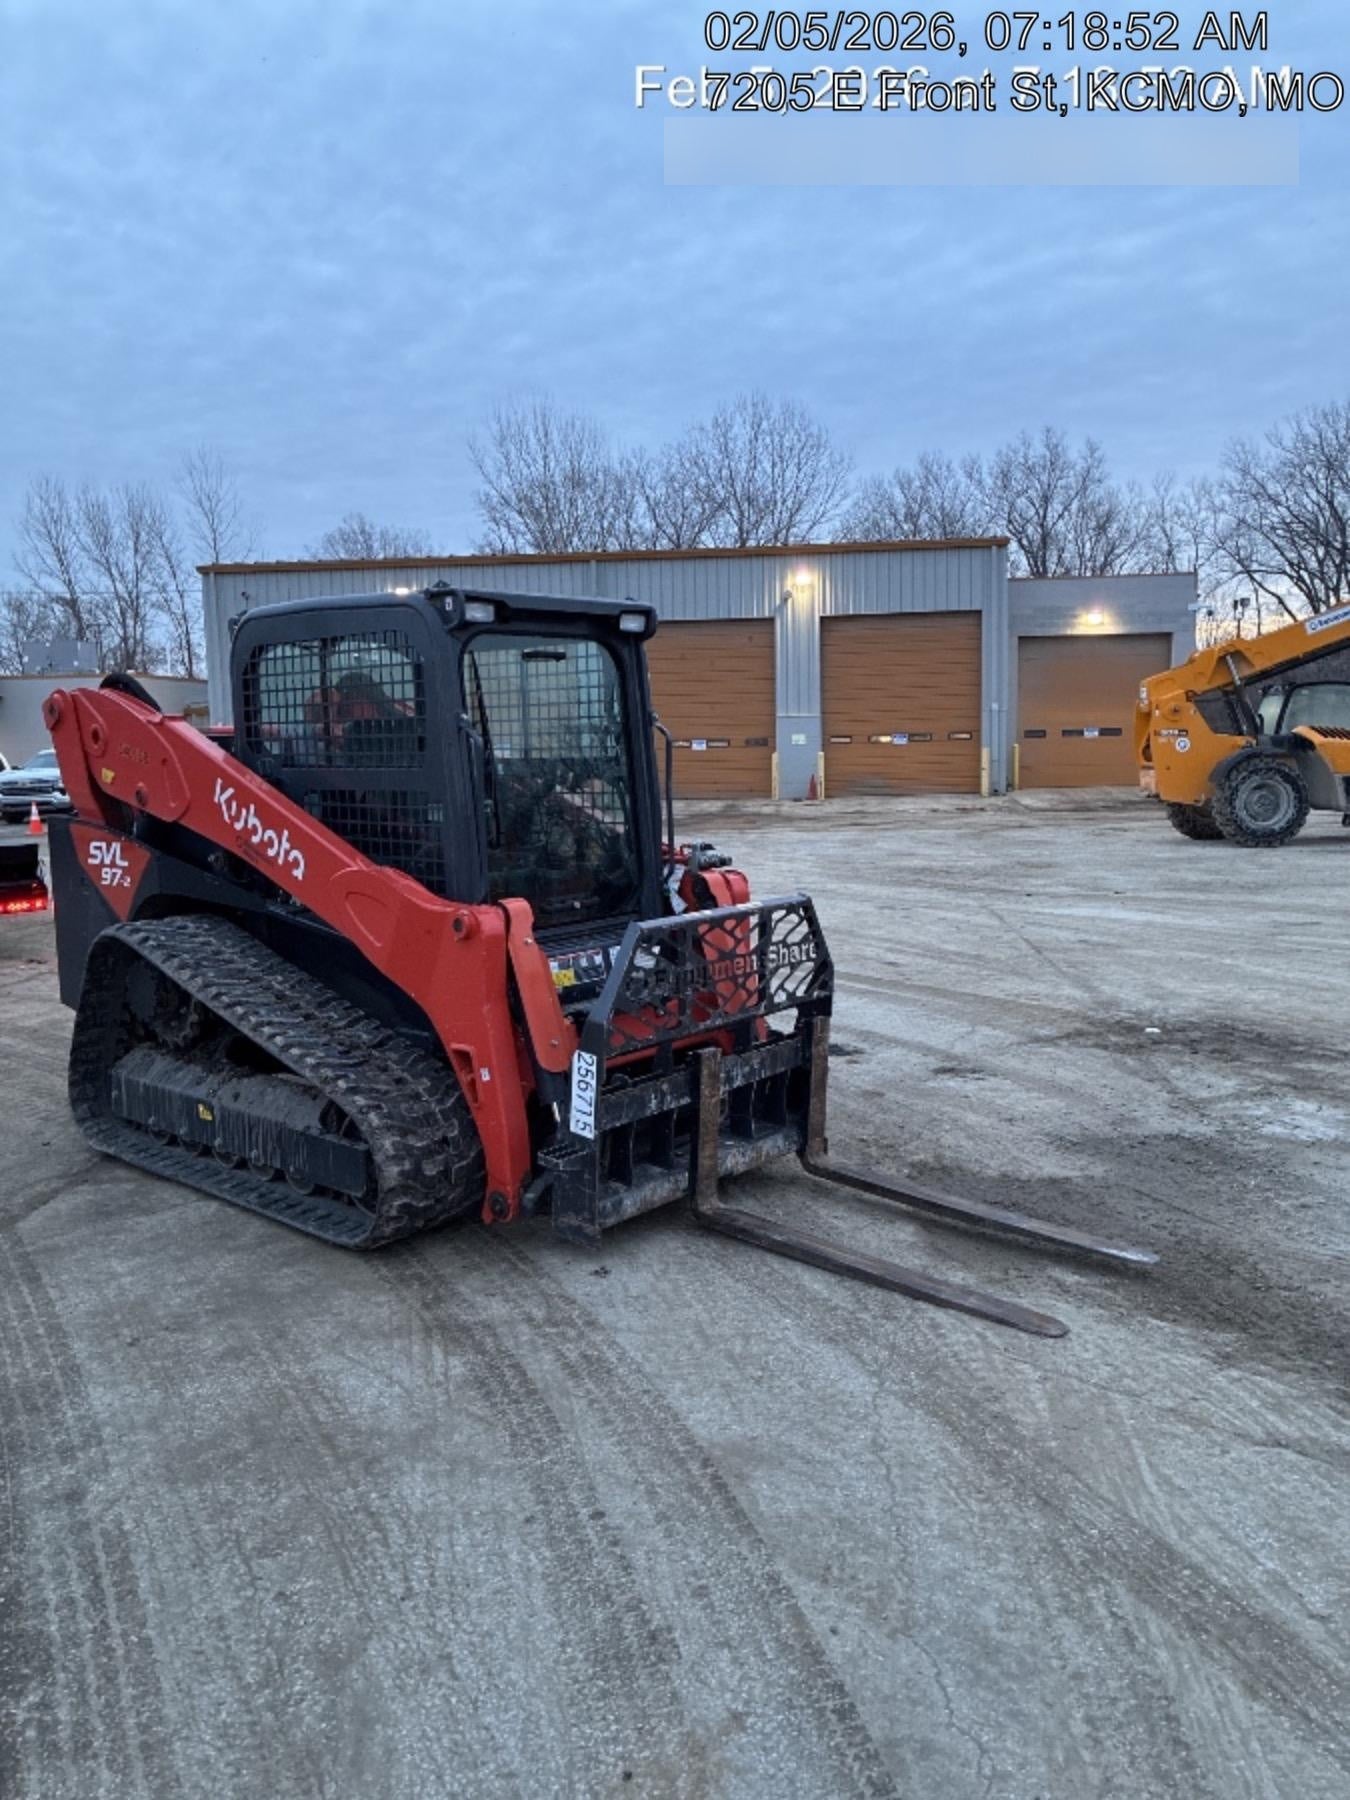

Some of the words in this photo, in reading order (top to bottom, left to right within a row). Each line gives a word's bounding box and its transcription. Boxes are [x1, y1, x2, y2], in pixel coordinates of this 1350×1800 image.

[87, 841, 129, 868] SVL
[213, 777, 305, 881] Kubota
[574, 1050, 596, 1135] 256715
